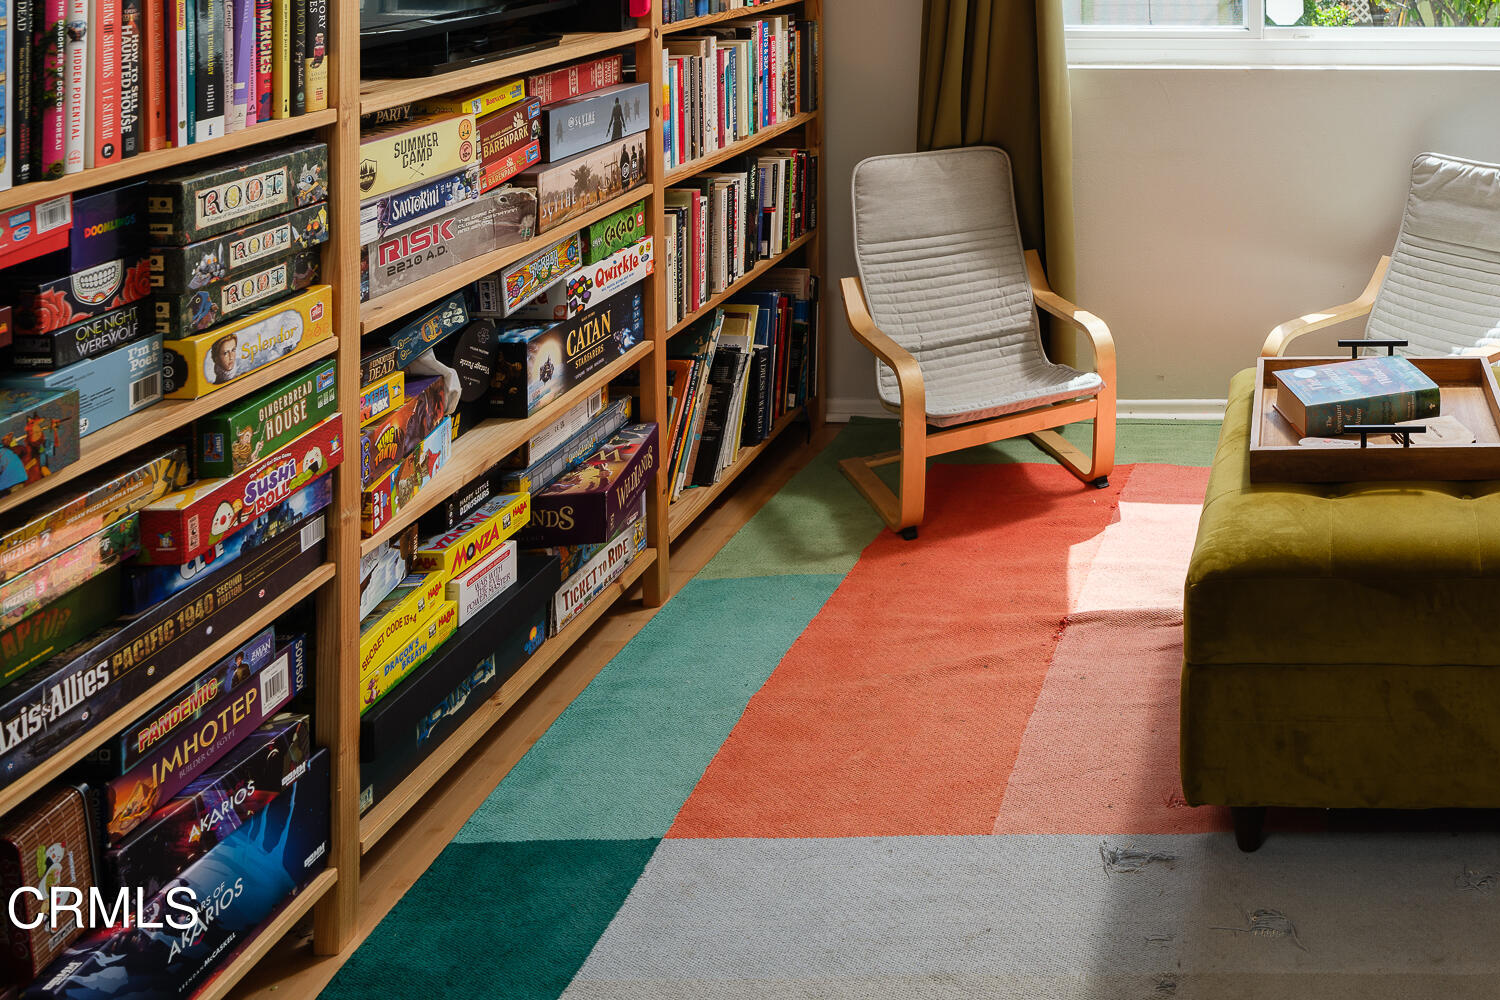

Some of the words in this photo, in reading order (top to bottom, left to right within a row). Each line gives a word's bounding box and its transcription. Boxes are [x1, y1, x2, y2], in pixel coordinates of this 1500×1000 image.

[16, 3, 28, 31] DEAD
[57, 0, 65, 17] THE
[56, 19, 65, 64] DAUGHTER
[102, 34, 114, 79] SHADOWS
[121, 24, 131, 88] HAUNTED
[130, 34, 139, 62] HOW
[207, 33, 215, 75] TECHNOLOGY
[259, 7, 273, 75] MERCIES
[56, 66, 64, 77] OF
[72, 48, 83, 84] HIDDEN
[131, 65, 139, 82] TO
[55, 80, 64, 113] DOCTOR
[71, 87, 82, 141] POTENTIAL
[121, 90, 130, 134] HOUSE
[130, 85, 138, 112] SELL
[375, 104, 411, 124] PARTY
[55, 115, 63, 151] MOREAU
[130, 114, 138, 122] A
[574, 112, 596, 127] SCYTHE
[393, 131, 440, 160] SUMMER
[402, 144, 434, 170] CAMP
[198, 170, 287, 217] ROOT
[541, 192, 577, 219] SCYTHE
[83, 214, 136, 239] DOOMLINGS
[231, 226, 290, 260] ROOT
[378, 216, 456, 268] RISK
[604, 215, 635, 247] CACAO
[386, 255, 423, 277] 2210
[425, 244, 449, 262] A.D.
[594, 253, 640, 289] Qwirkle
[223, 266, 287, 307] ROOT
[75, 319, 103, 341] ONE
[104, 306, 138, 331] NIGHT
[76, 321, 139, 357] WEREWOLF
[566, 309, 611, 358] CATAN
[127, 344, 150, 362] I'm
[241, 324, 299, 362] Splendor
[575, 343, 605, 370] STARFARERS
[129, 352, 159, 372] Poet
[368, 359, 395, 383] DEAD
[258, 379, 313, 422] GINGERBREAD
[364, 383, 390, 407] MEGA
[371, 397, 390, 416] BOX
[265, 398, 309, 441] HOUSE
[1335, 403, 1343, 434] Covenant
[243, 457, 297, 506] SUSHI
[252, 480, 291, 516] ROLL
[459, 488, 490, 517] DINOSAURS
[512, 500, 528, 517] HABA
[450, 521, 500, 576] MONZA
[215, 572, 243, 597] SECOND
[427, 581, 443, 600] HABA
[561, 568, 597, 612] TICKET
[605, 536, 630, 571] RIDE
[216, 582, 243, 606] EDITION
[111, 617, 176, 677] PACIFIC
[176, 592, 215, 632] 1940
[437, 607, 456, 628] HABA
[361, 636, 385, 672] SECRET
[385, 618, 404, 640] CODE
[383, 636, 420, 677] DRAGON'S
[401, 642, 428, 672] BREATH
[294, 638, 305, 692] KOSMOS
[50, 659, 110, 722] Allies
[137, 677, 219, 754] PANDEMIC
[150, 687, 258, 789] IMHOTEP
[188, 780, 256, 843] AKARIOS
[167, 876, 244, 964] AKARIOS
